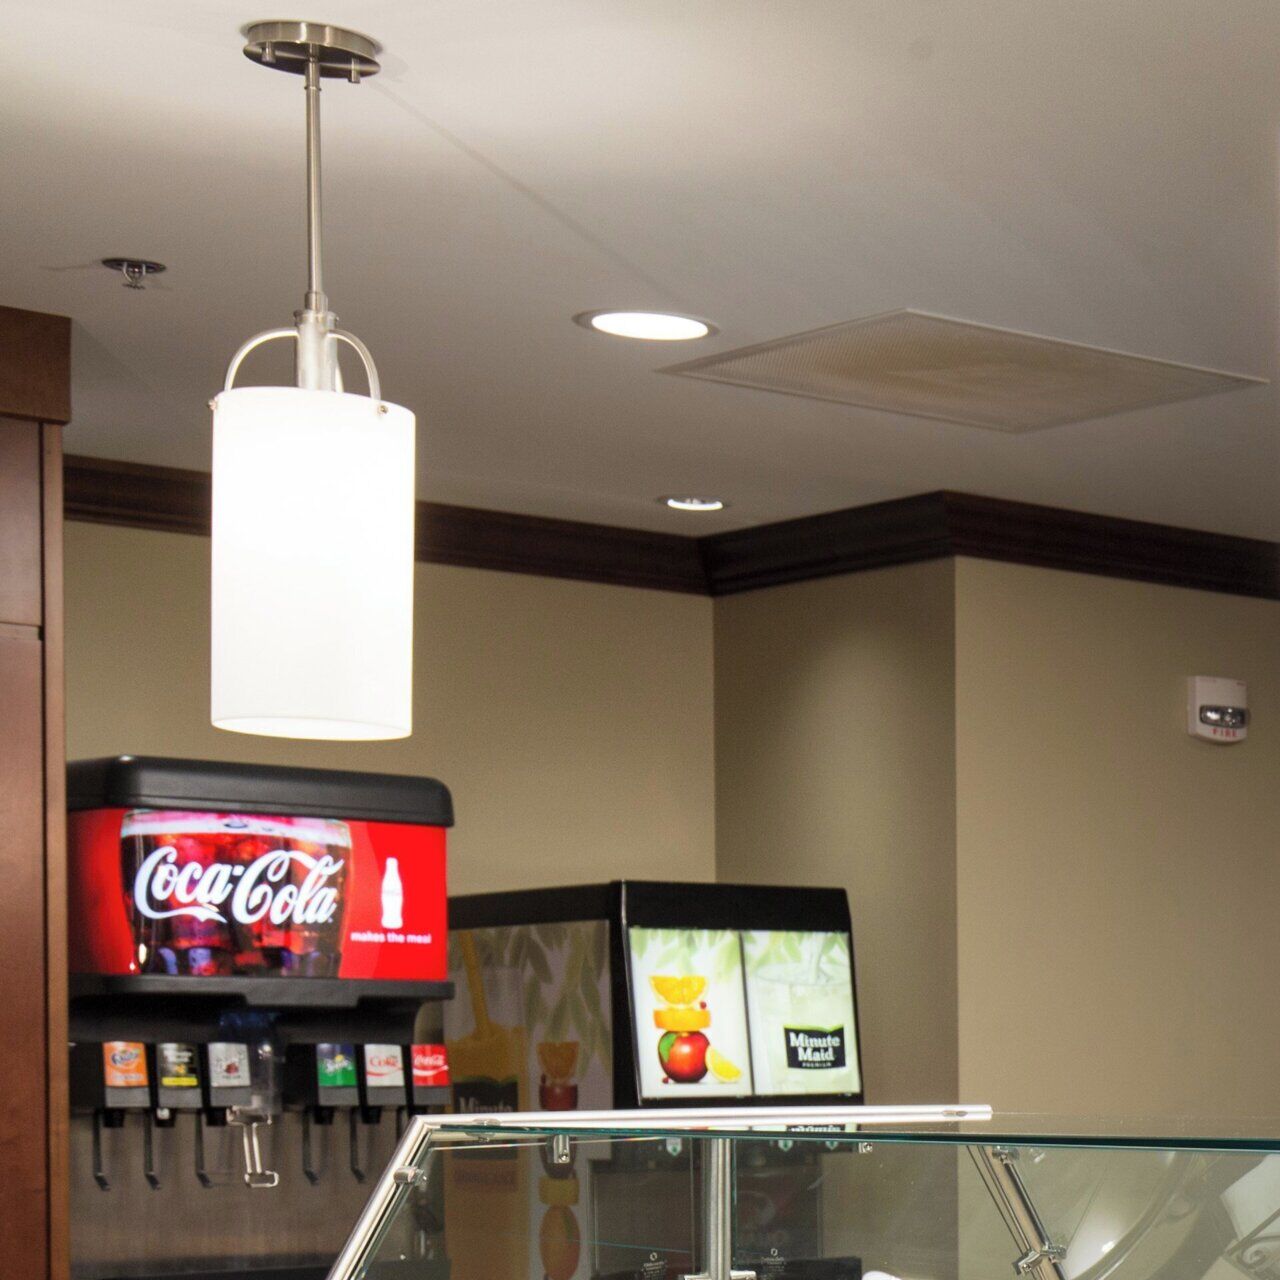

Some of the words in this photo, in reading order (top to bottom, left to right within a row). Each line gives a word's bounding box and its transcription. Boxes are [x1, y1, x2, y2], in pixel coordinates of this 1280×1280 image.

[1210, 727, 1238, 738] FIRE
[134, 846, 345, 925] Coca-Cola
[350, 931, 385, 943] makes
[386, 931, 405, 943] the
[406, 932, 432, 944] meal
[788, 1031, 841, 1048] Minute
[797, 1047, 835, 1061] Maid
